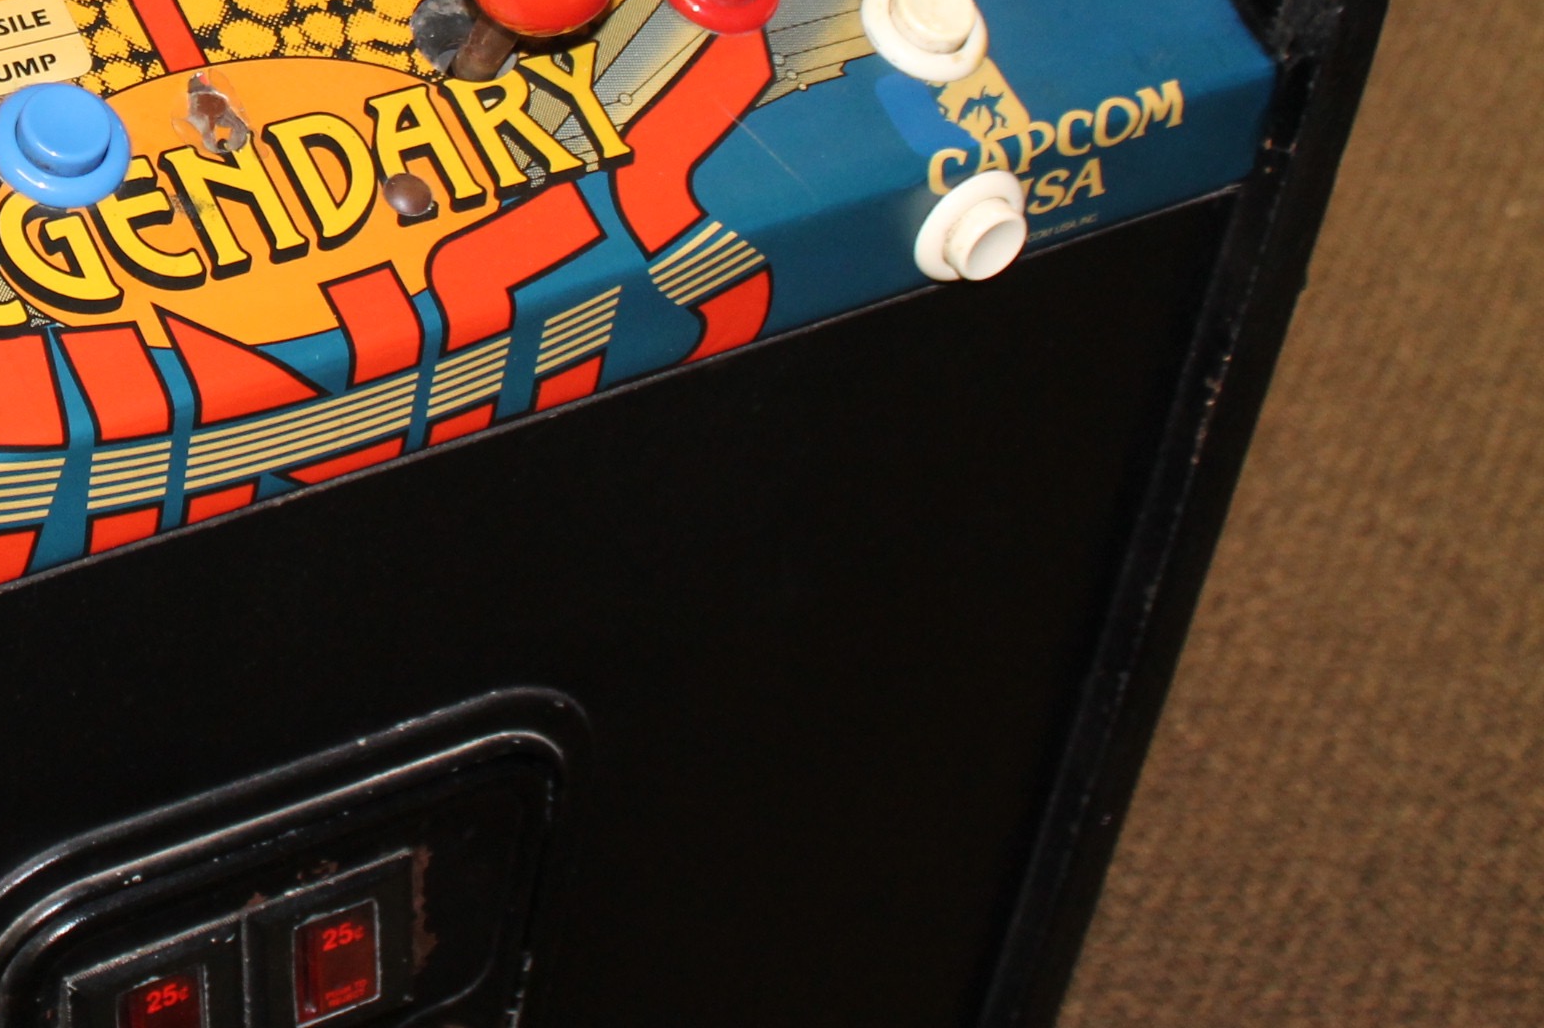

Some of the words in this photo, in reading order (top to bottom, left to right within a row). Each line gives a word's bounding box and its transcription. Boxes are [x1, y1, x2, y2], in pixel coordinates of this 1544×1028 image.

[928, 79, 1184, 196] CAPCOM
[1019, 157, 1106, 215] SA
[322, 922, 364, 951] 25¢
[146, 983, 189, 1014] 25¢
